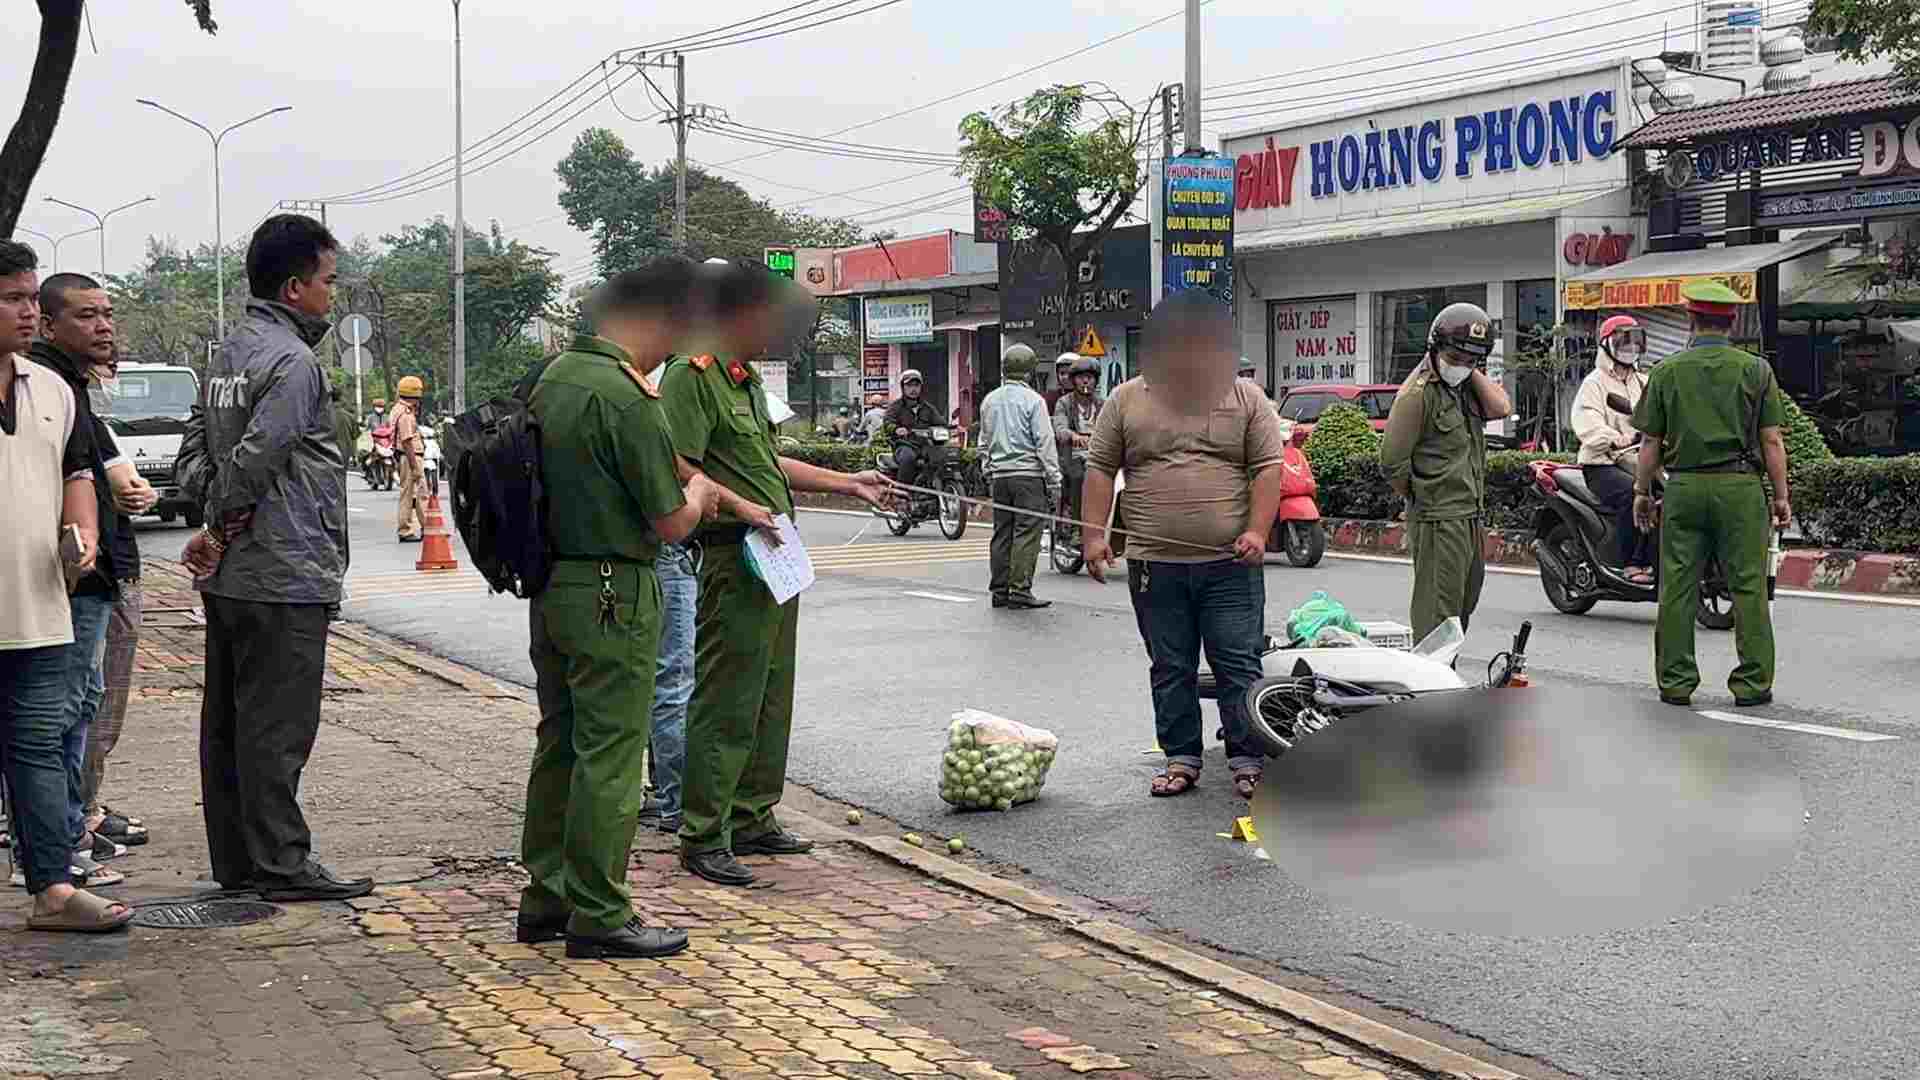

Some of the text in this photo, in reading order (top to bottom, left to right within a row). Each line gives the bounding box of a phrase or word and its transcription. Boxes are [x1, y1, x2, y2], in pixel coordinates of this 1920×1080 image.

[1310, 119, 1446, 199] HOÀNG
[1455, 90, 1617, 178] PHONG
[1295, 336, 1326, 358] NAM
